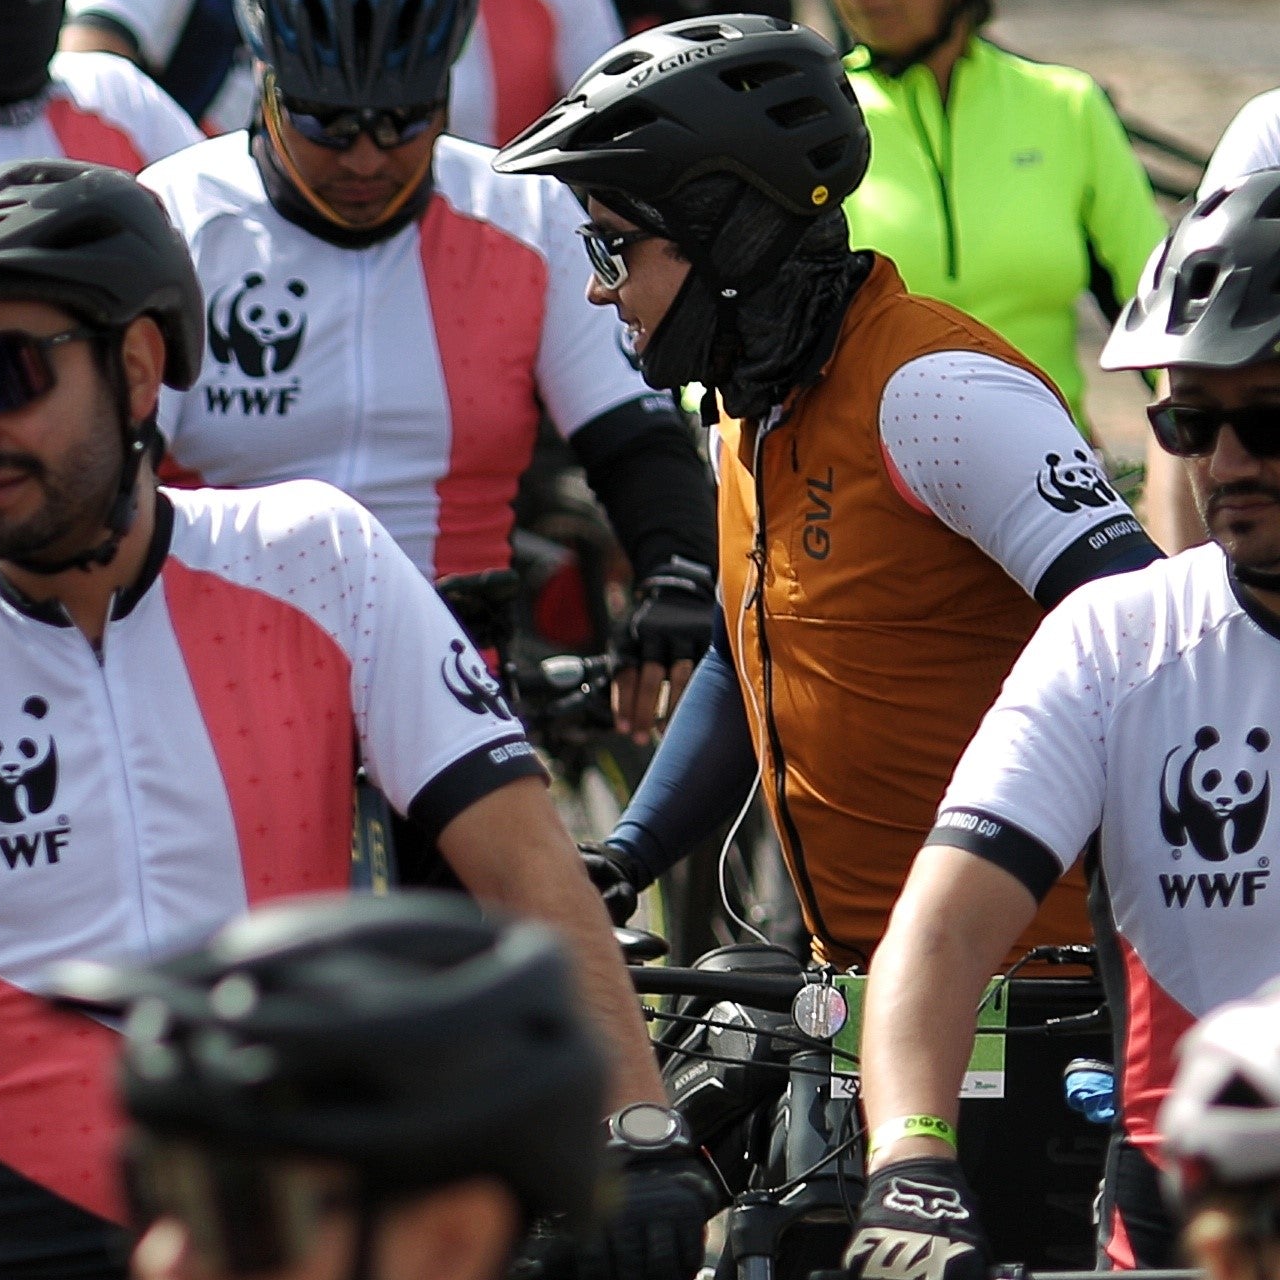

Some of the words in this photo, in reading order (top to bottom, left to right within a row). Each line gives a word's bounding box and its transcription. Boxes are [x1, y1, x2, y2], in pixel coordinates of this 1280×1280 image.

[205, 385, 300, 416] WWF
[802, 466, 832, 560] GVL
[1159, 870, 1270, 909] WWF
